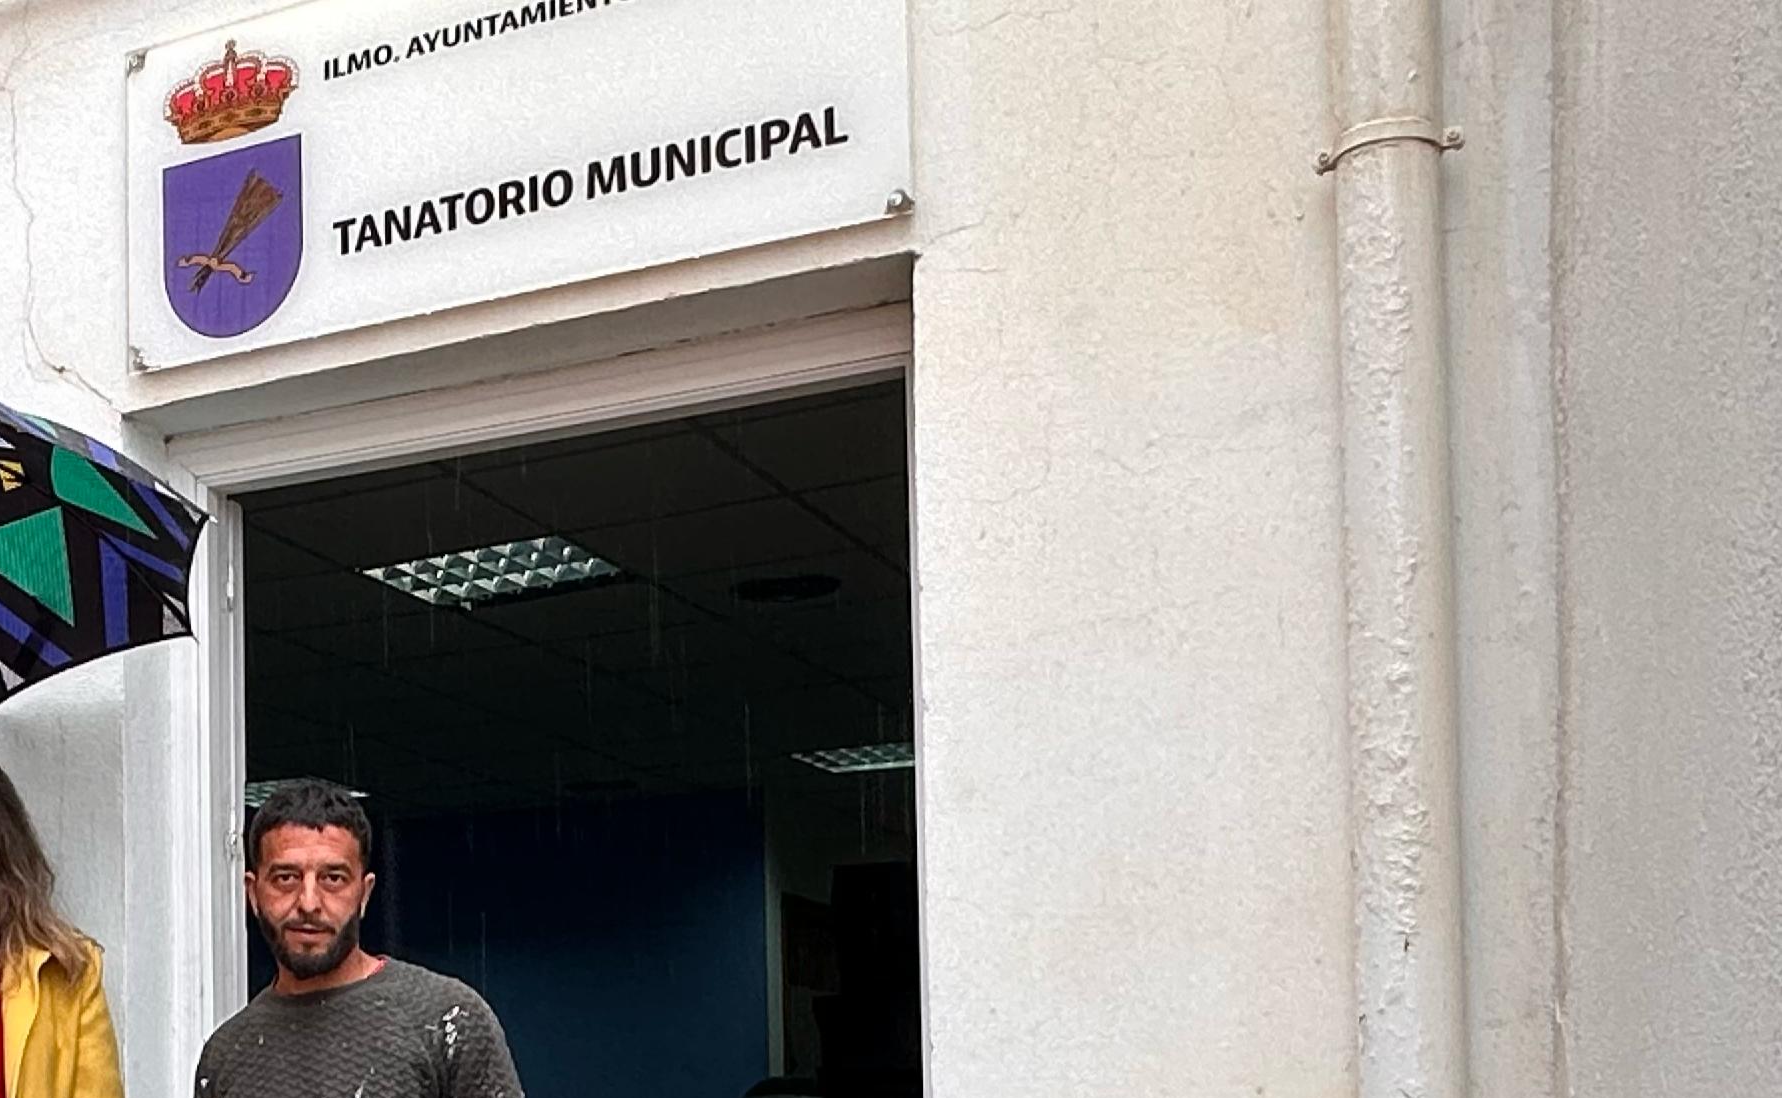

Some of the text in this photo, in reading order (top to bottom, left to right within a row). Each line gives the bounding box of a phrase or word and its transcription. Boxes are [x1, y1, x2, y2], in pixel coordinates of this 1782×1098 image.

[323, 0, 629, 81] ILMO. AYUNTAMIEN
[332, 106, 849, 256] TANATORIO MUNICIPAL
